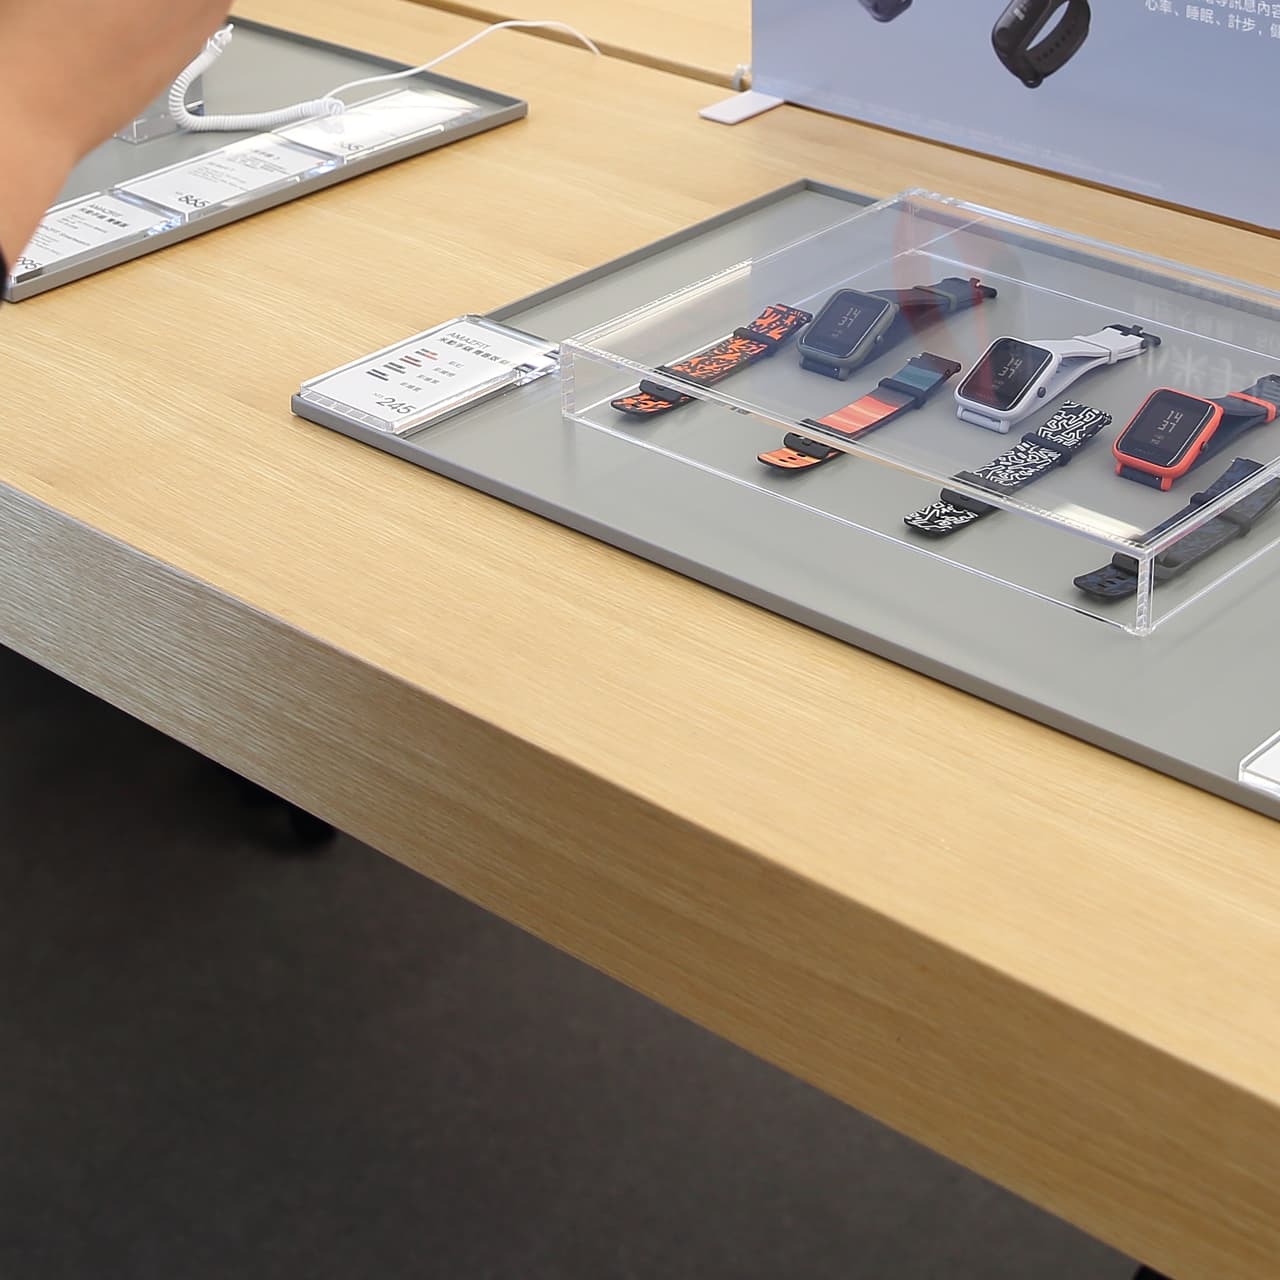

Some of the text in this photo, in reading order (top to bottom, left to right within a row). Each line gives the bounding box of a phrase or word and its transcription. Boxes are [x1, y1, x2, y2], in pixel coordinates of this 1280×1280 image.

[375, 397, 417, 414] 245
[1166, 410, 1183, 423] 14
[1157, 419, 1176, 433] 37
